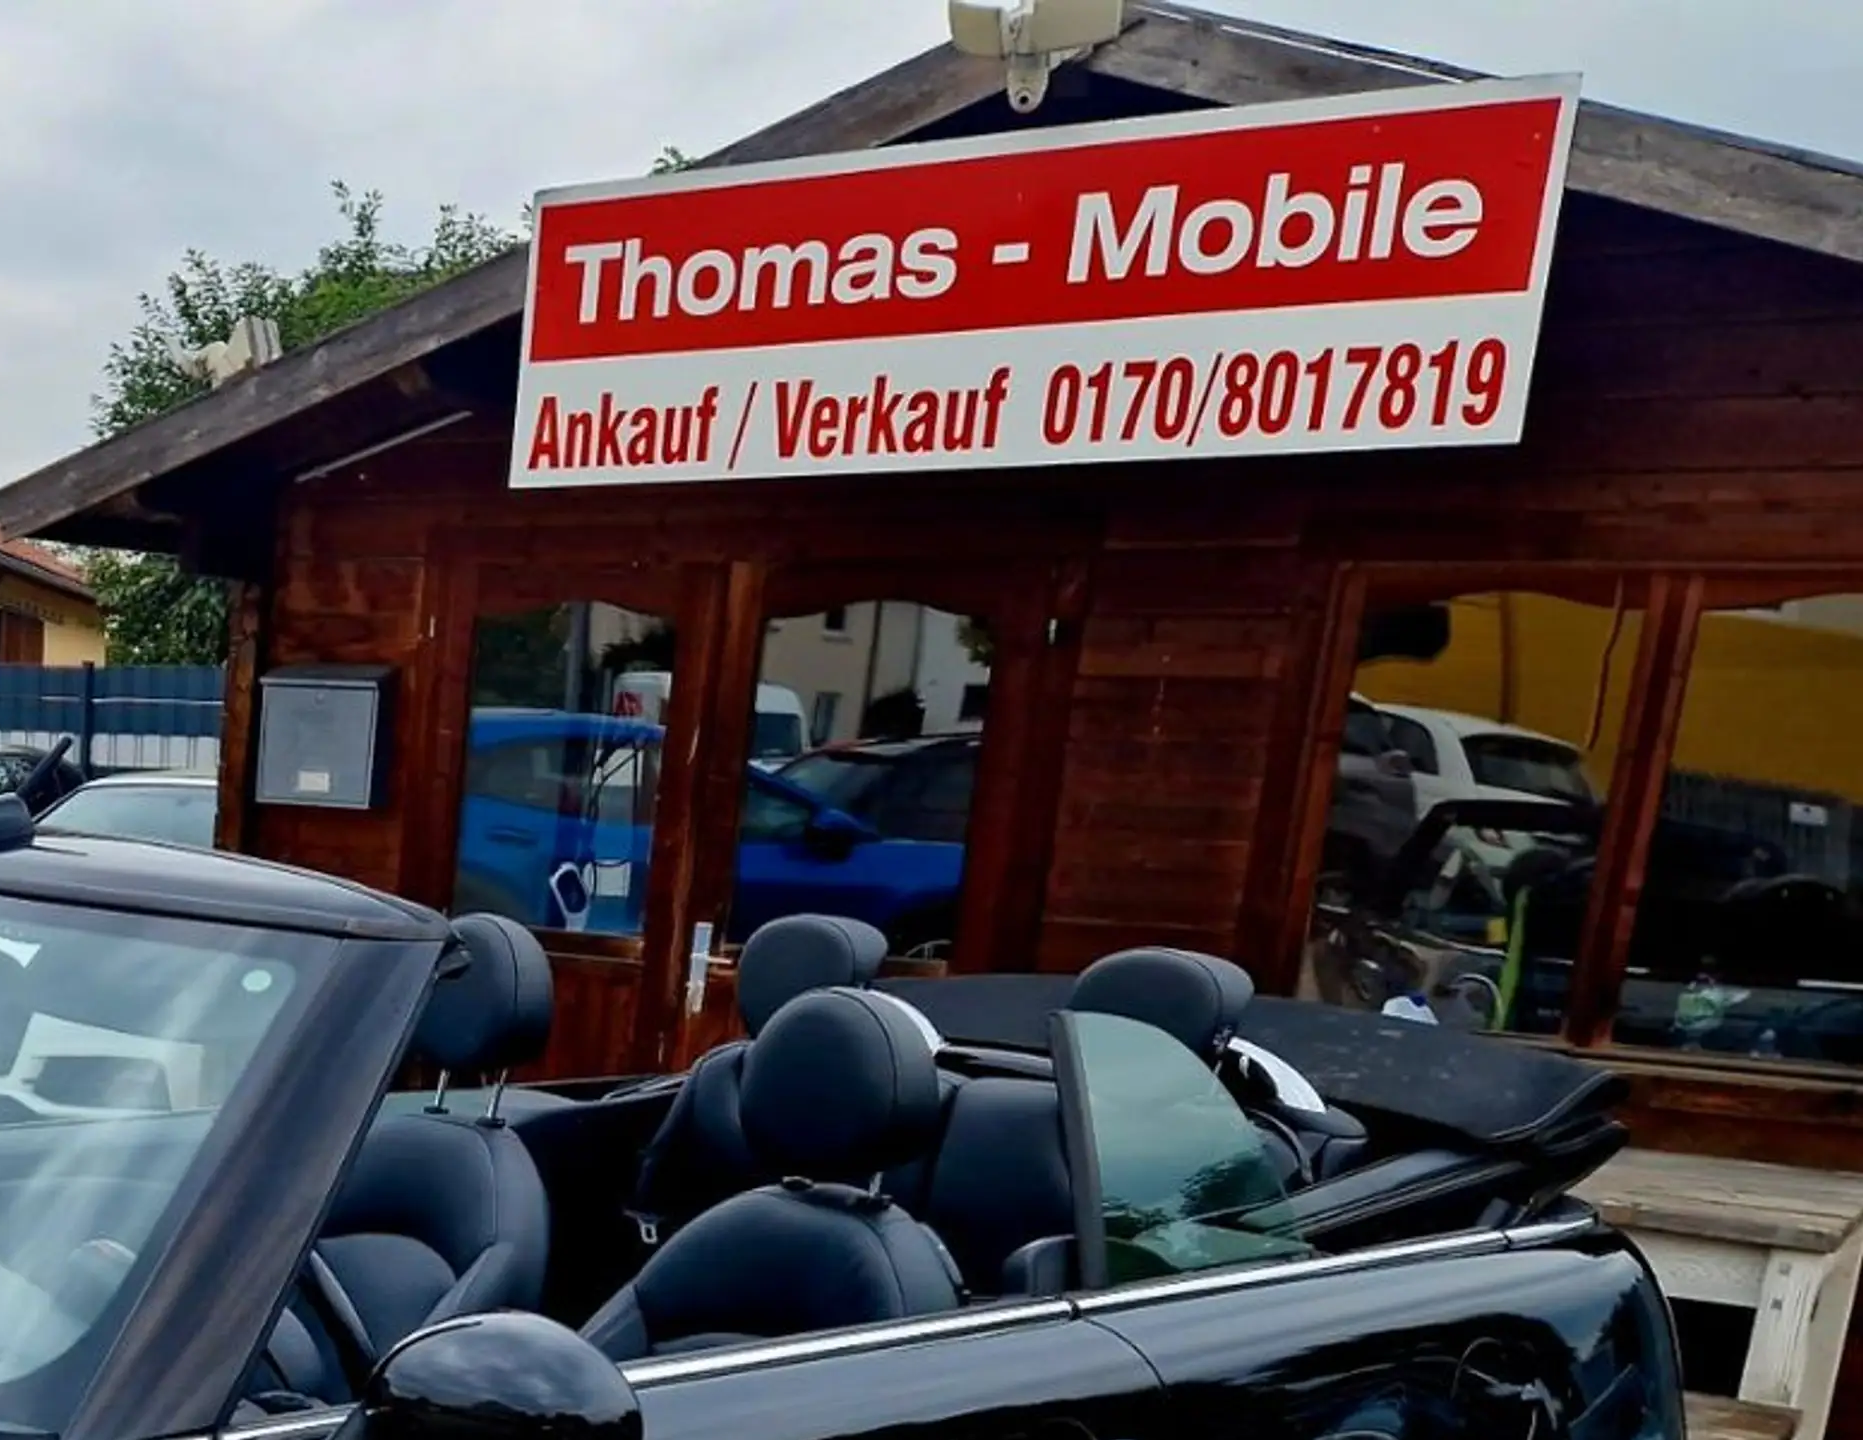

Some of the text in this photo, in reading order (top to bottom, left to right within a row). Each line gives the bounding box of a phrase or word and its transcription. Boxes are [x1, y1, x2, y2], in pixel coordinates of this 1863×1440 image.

[564, 162, 1484, 325] Thomas - Mobile
[527, 338, 1507, 470] Ankauf / Verkauf 0170/8017819
